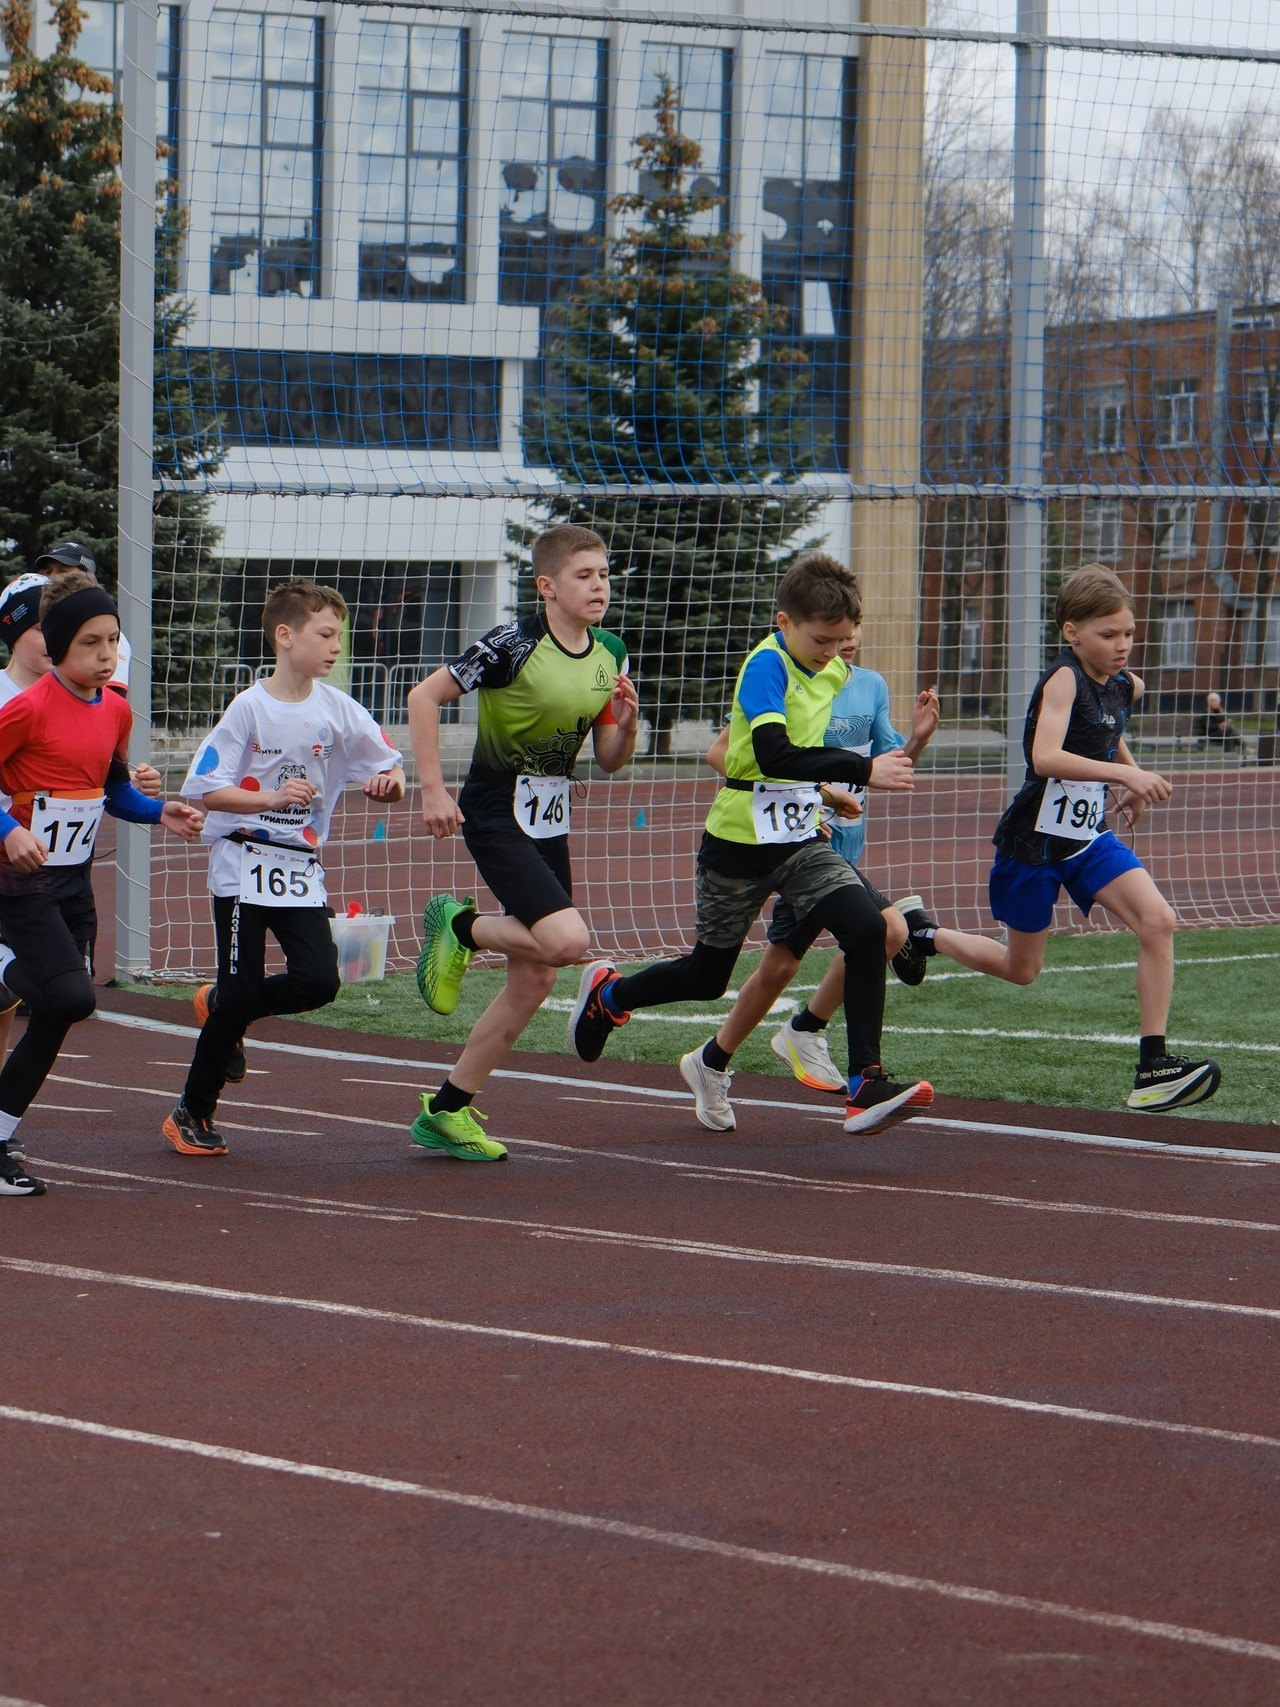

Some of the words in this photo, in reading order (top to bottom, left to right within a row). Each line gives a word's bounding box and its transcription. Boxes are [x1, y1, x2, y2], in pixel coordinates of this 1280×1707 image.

[524, 792, 564, 827] 146
[1053, 794, 1098, 830] 198
[43, 818, 97, 853] 174
[250, 864, 309, 898] 165
[1152, 1066, 1183, 1078] balance
